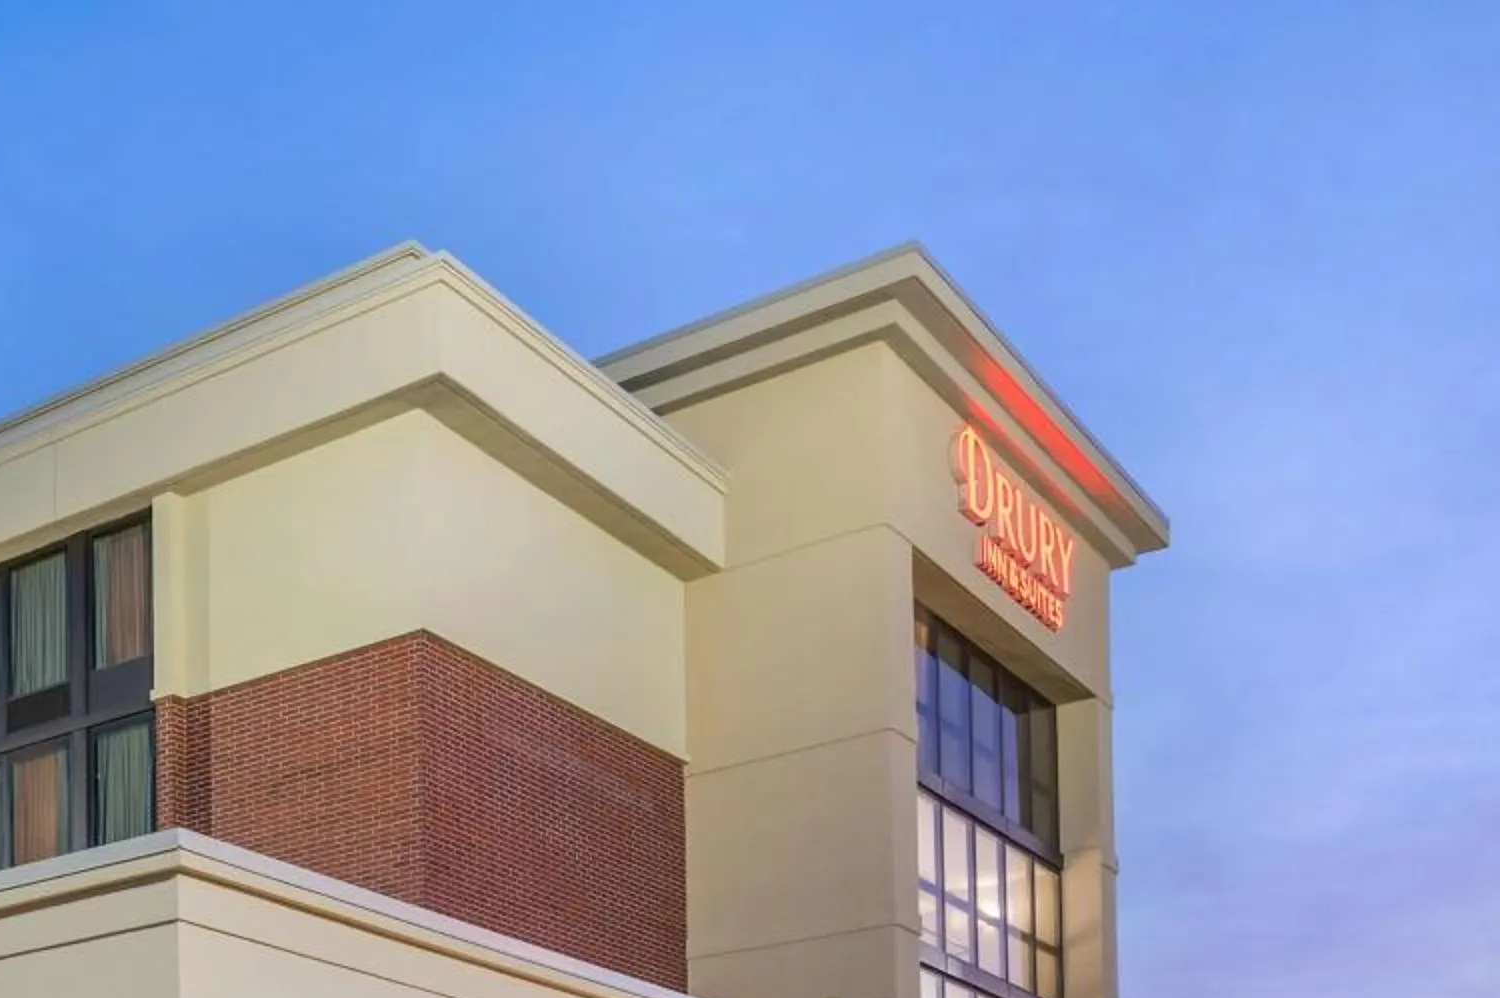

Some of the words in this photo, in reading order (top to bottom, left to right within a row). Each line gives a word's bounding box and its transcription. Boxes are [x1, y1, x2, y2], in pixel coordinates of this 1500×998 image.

[958, 426, 1074, 594] DRURY
[982, 534, 1007, 581] INN
[1020, 567, 1063, 629] SUITES
